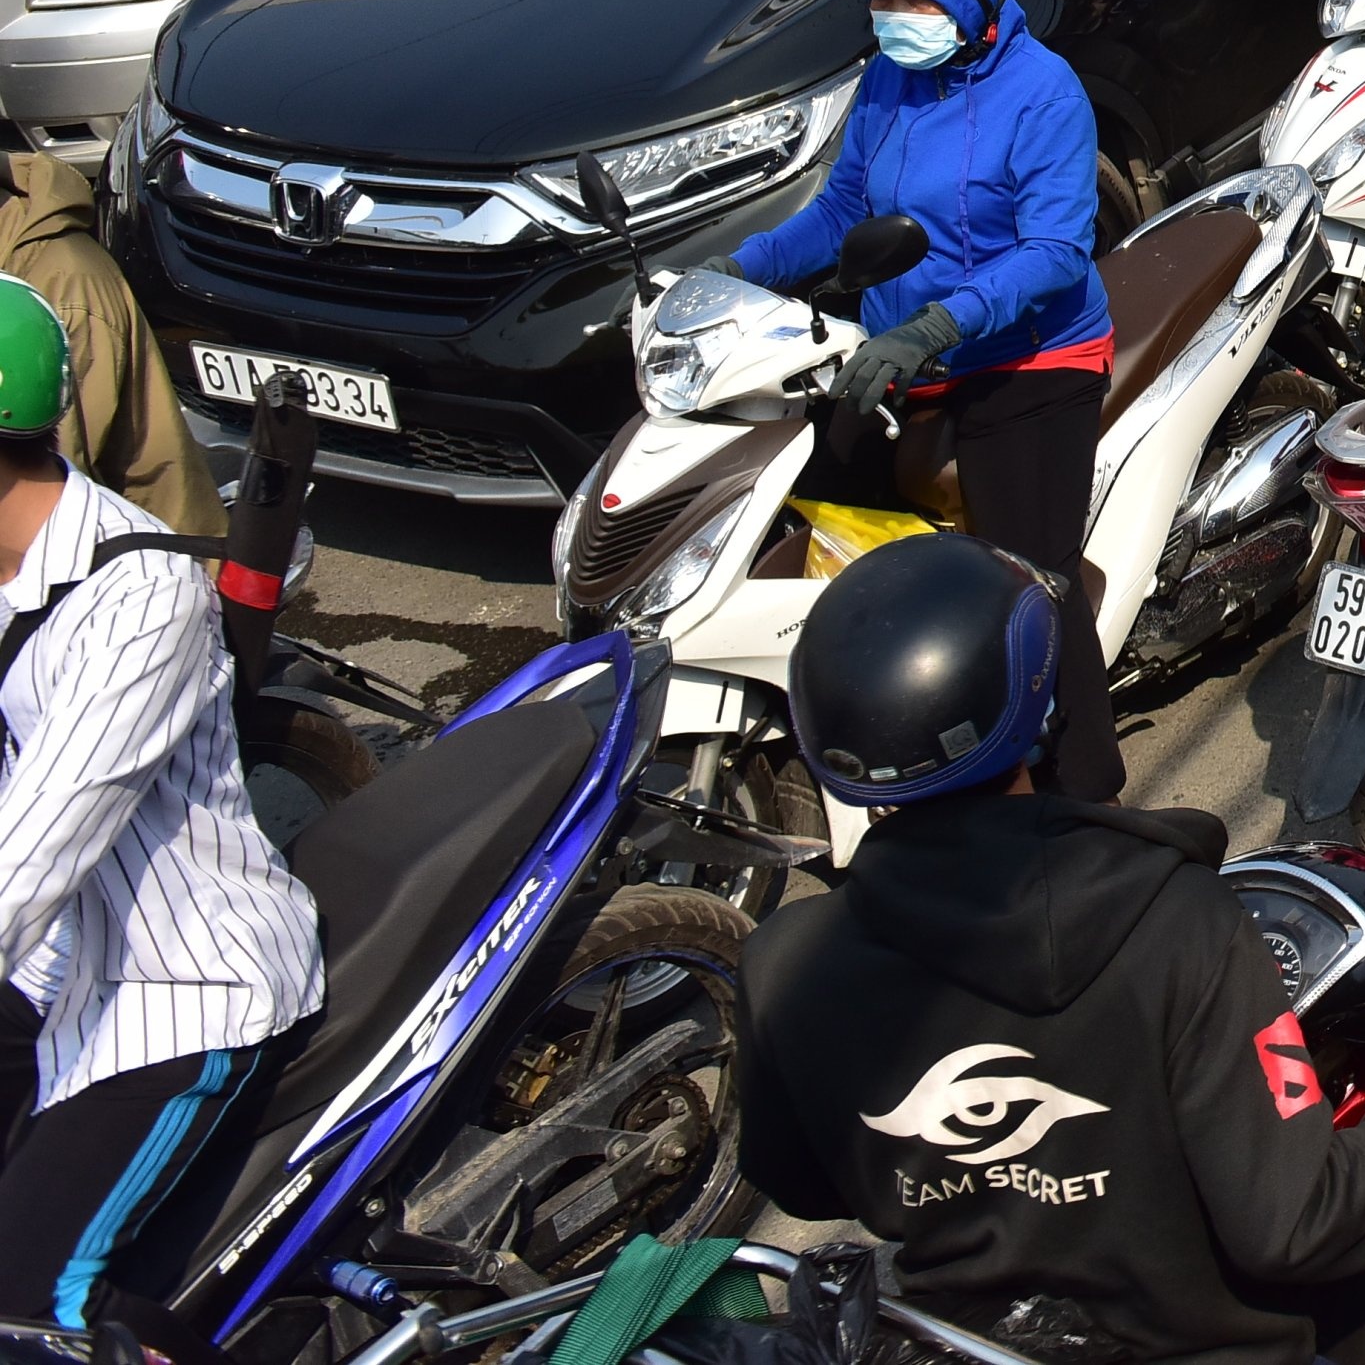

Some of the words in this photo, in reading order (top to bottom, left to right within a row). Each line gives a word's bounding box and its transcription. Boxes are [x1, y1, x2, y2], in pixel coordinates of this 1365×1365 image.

[1228, 280, 1285, 359] VISION
[894, 1168, 977, 1207] TEAM
[984, 1163, 1112, 1206] SECRET
